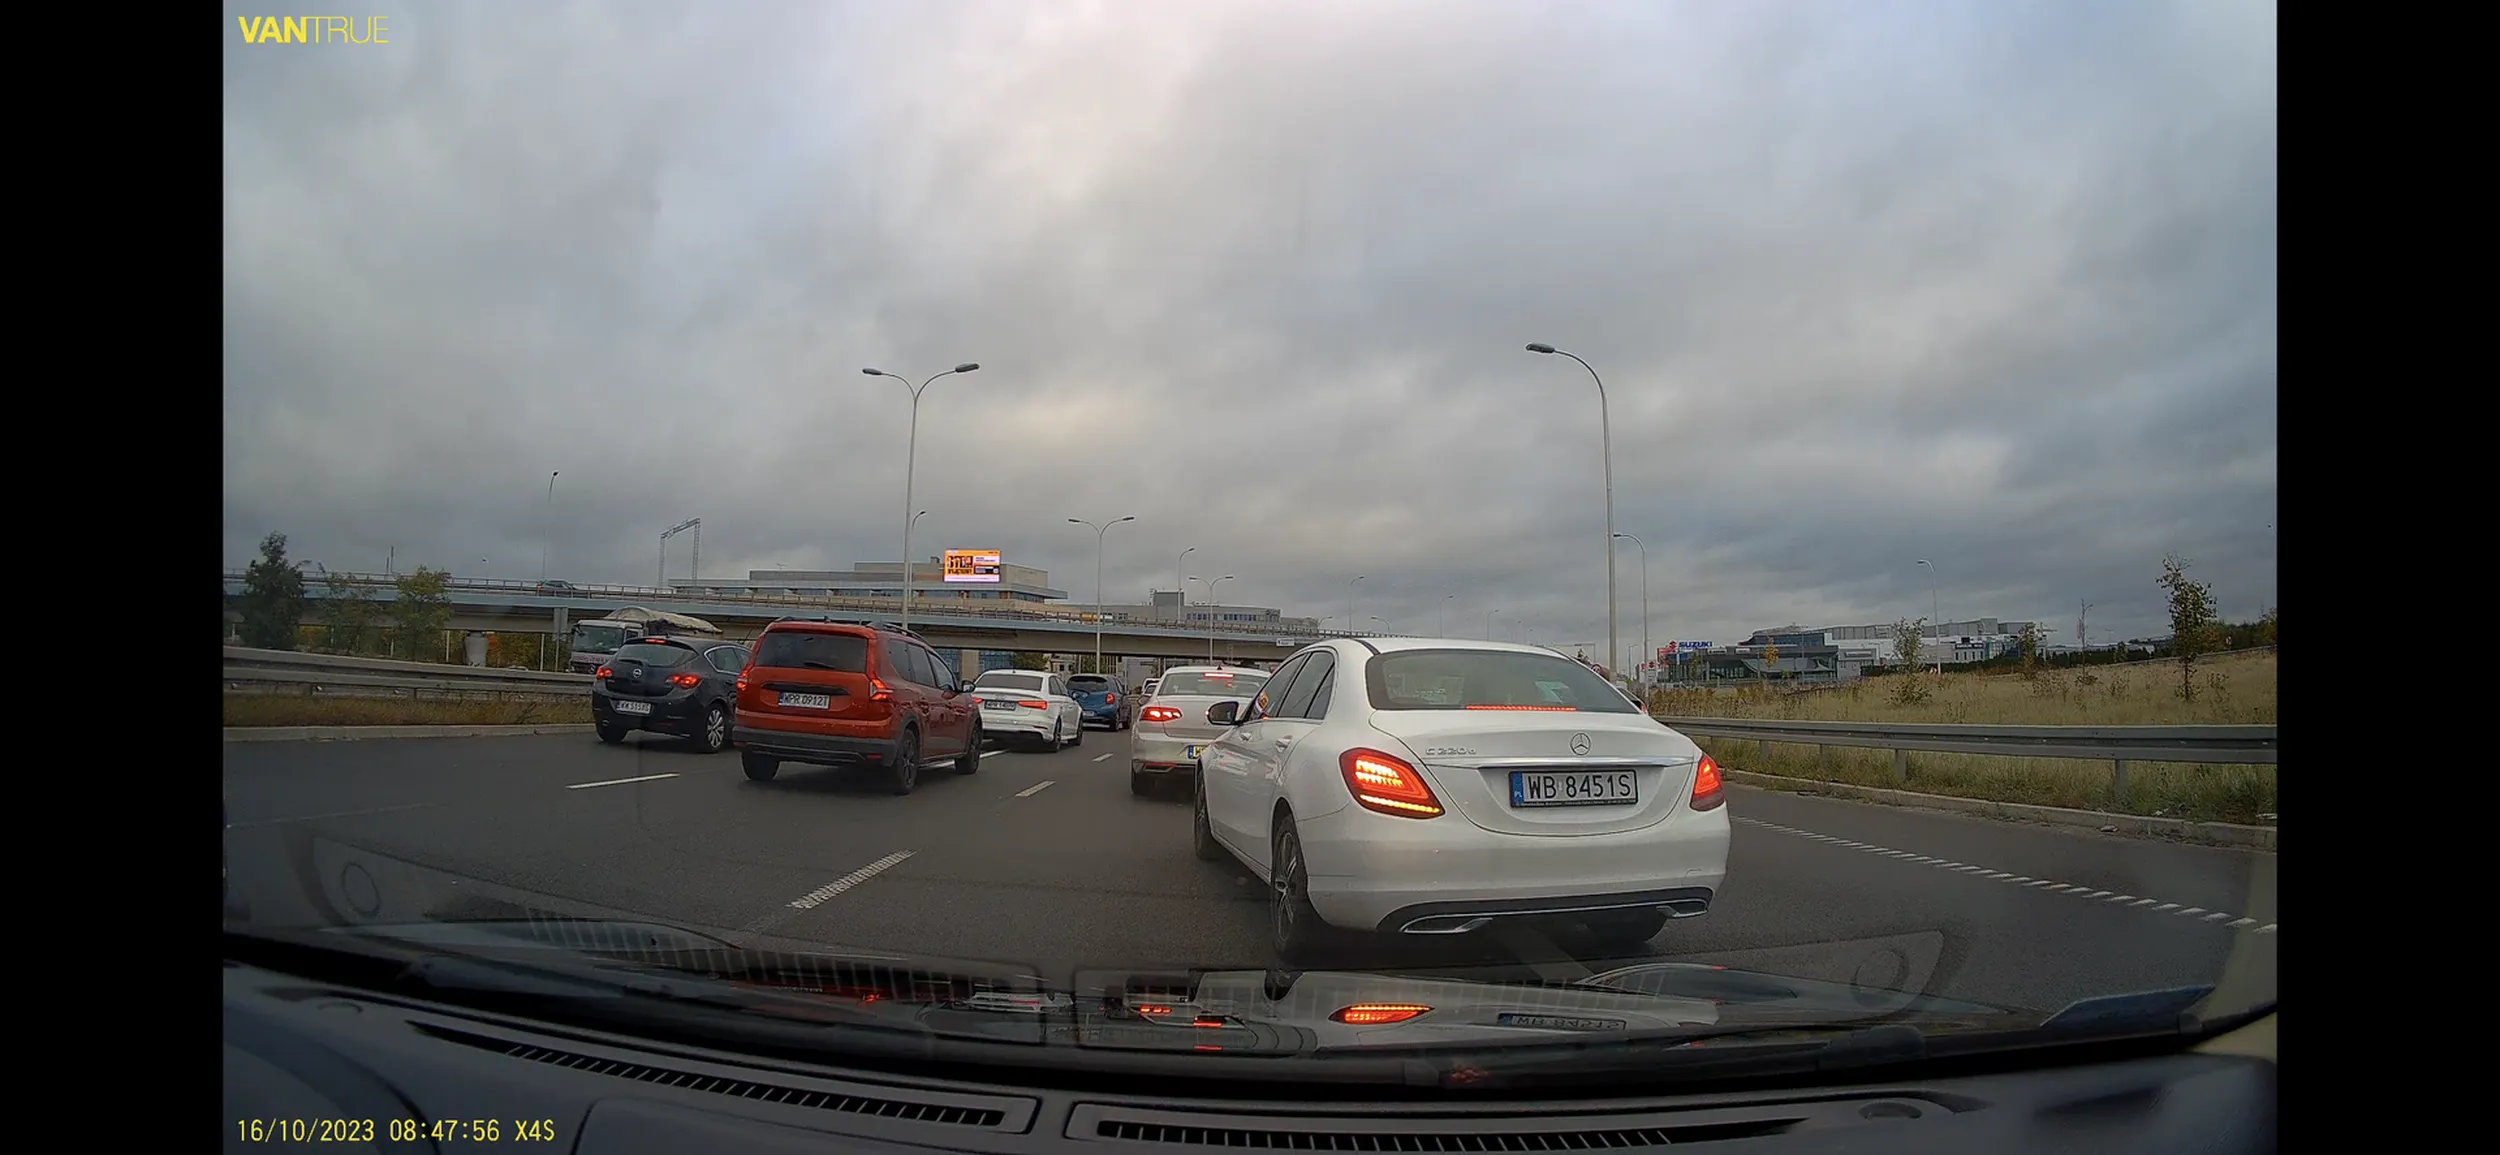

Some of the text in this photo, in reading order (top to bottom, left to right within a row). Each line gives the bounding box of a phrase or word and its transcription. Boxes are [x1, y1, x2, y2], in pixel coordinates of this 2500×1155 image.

[784, 692, 800, 704] WPR
[1528, 774, 1631, 799] WB 8451S
